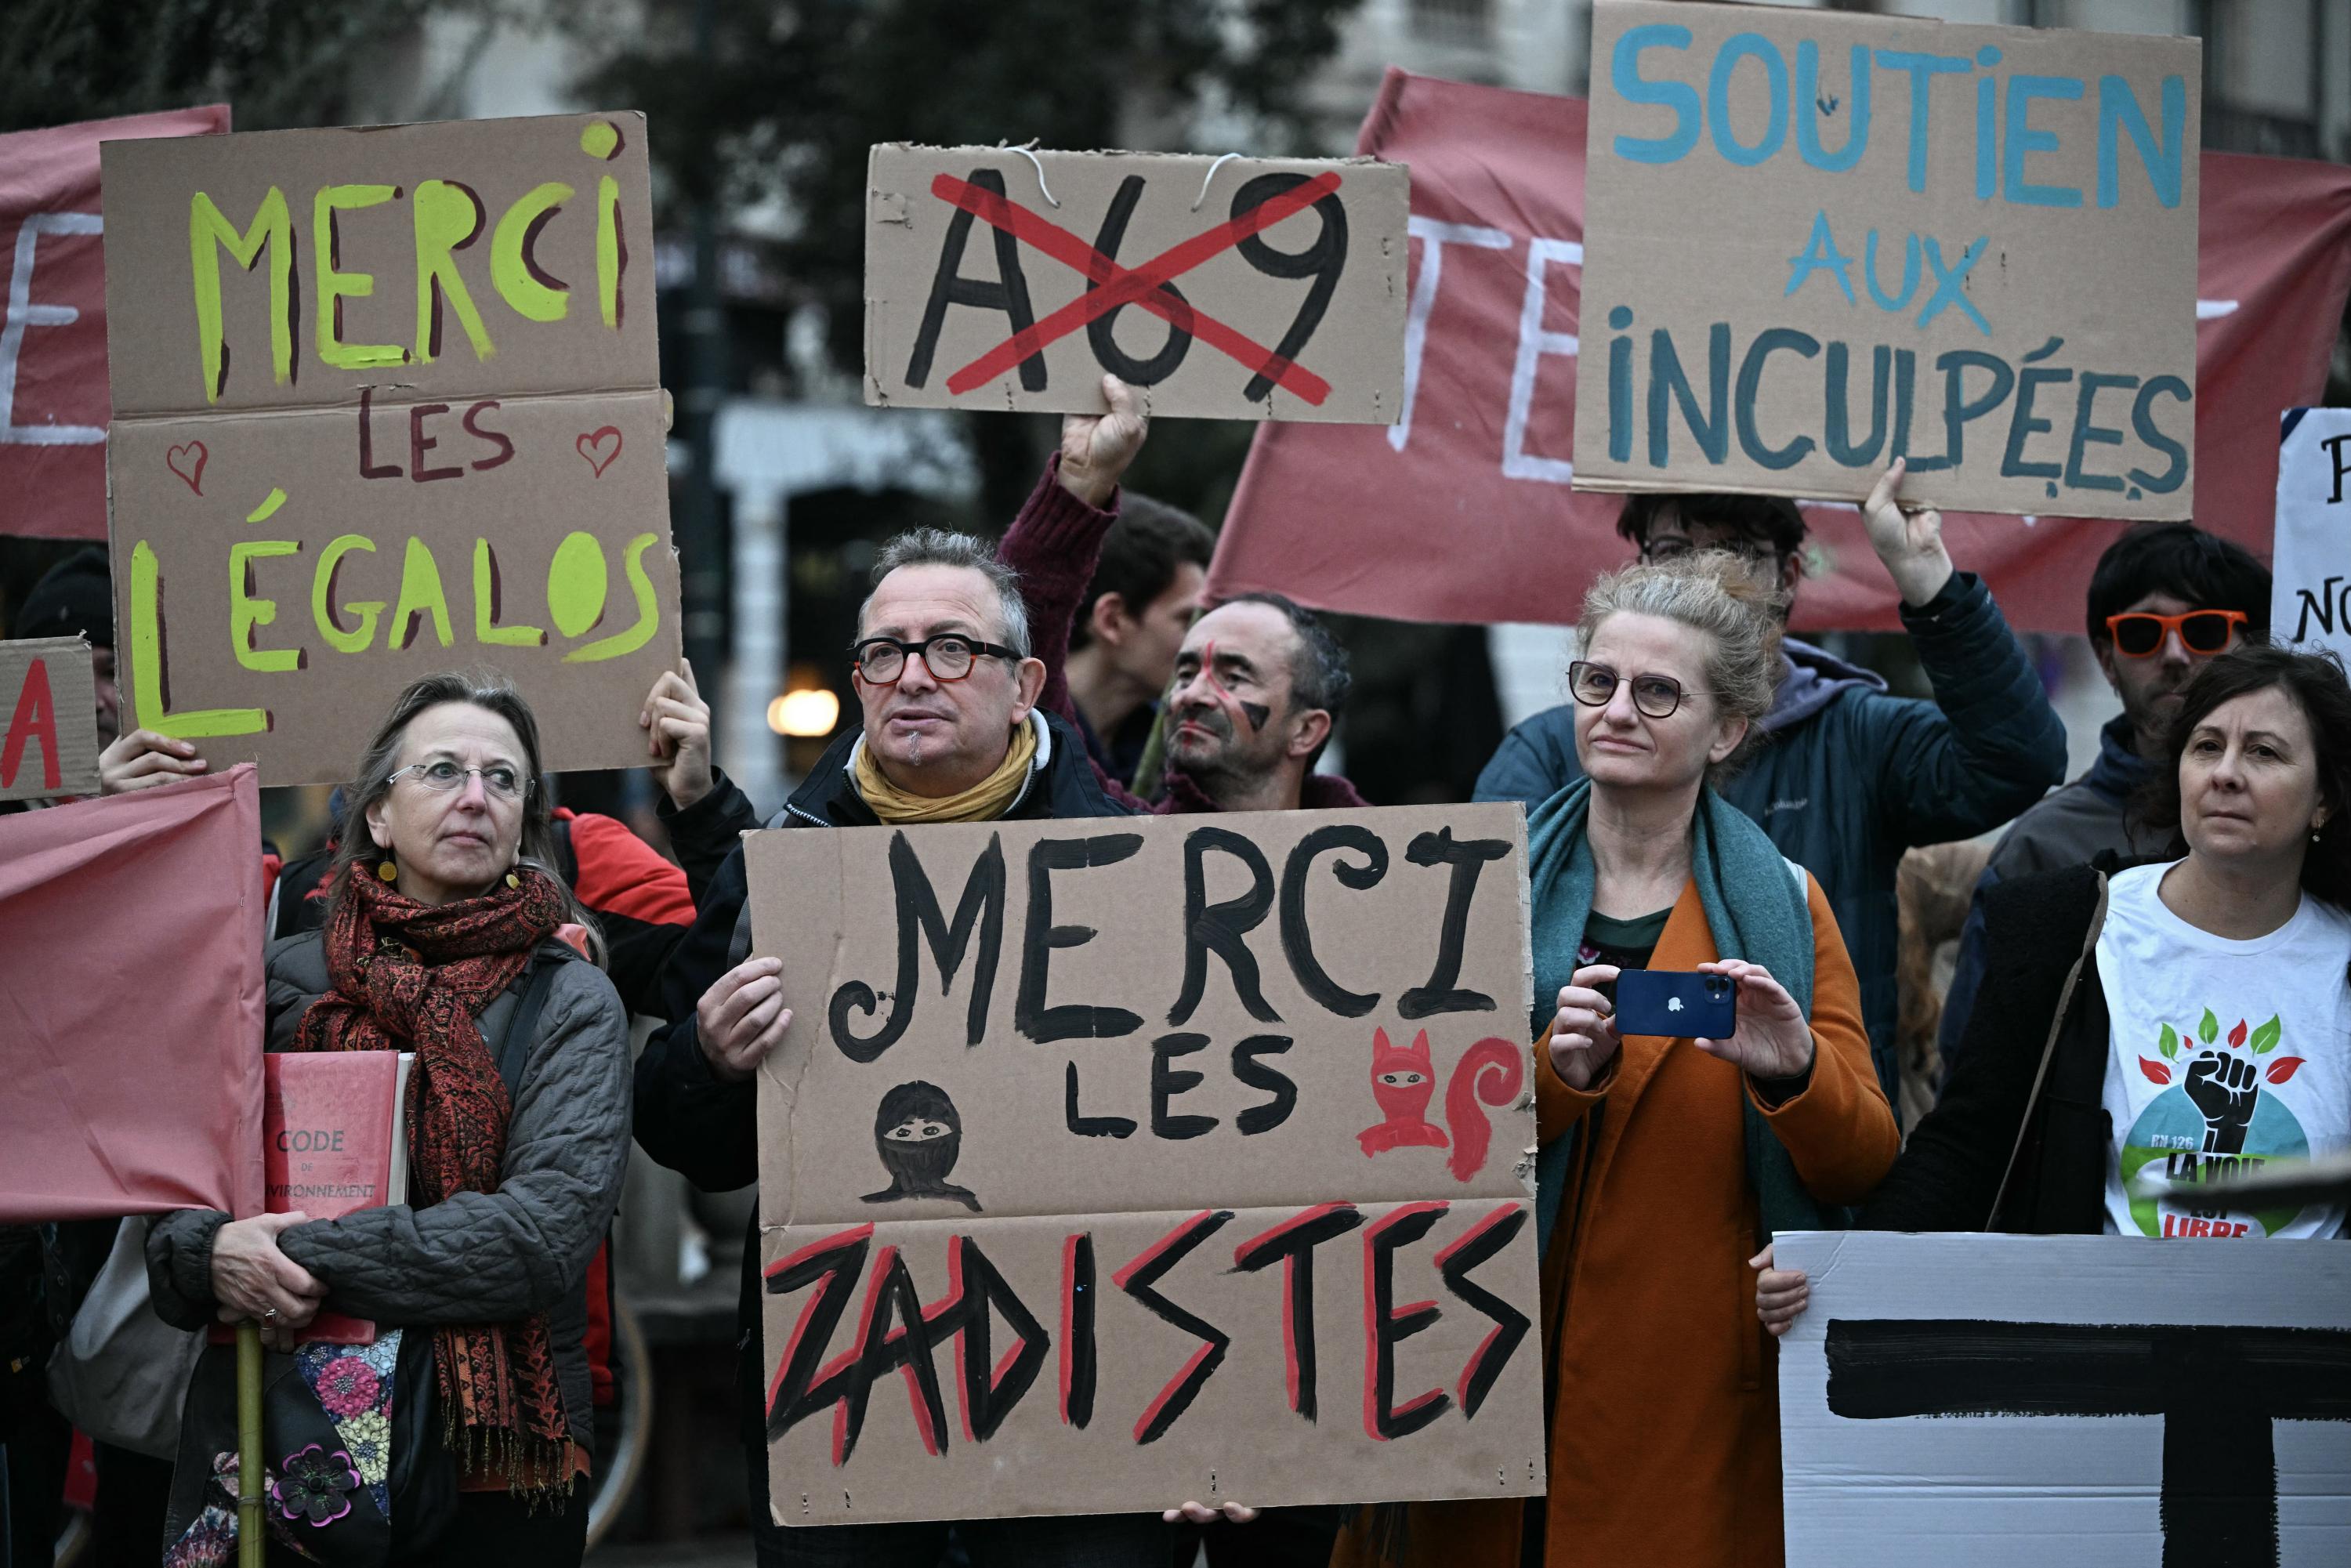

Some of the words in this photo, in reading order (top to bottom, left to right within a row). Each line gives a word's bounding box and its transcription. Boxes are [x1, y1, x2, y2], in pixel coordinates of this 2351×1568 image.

[904, 168, 1349, 403] A69
[1784, 209, 1992, 336] AUX
[358, 389, 516, 483] LES
[131, 487, 660, 739] LÉGALOS
[828, 824, 1513, 1063] MERCI
[1067, 1033, 1297, 1139] LES
[267, 1184, 376, 1199] VIRONNEMENT
[277, 1130, 345, 1153] CODE
[301, 1163, 313, 1172] DE
[2151, 1134, 2168, 1148] RN
[2172, 1135, 2194, 1150] 126
[2166, 1153, 2197, 1183] LA
[766, 1200, 1531, 1467] ZADISTES
